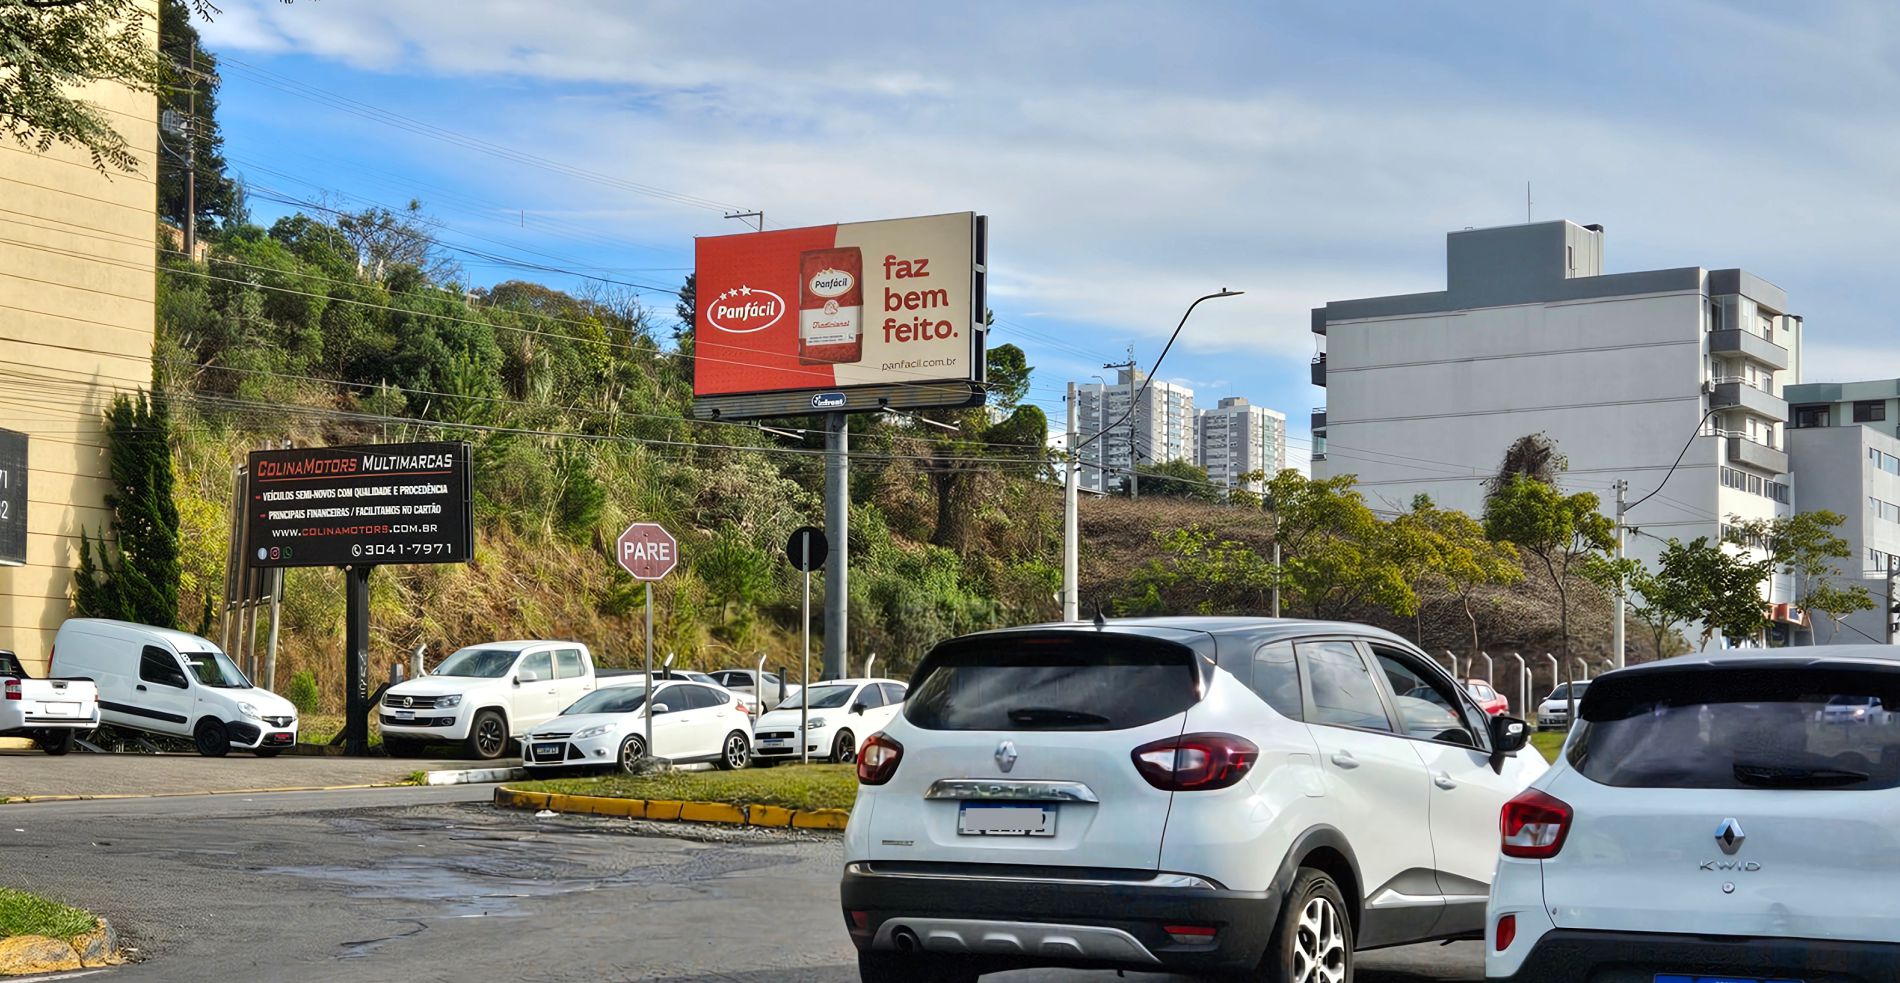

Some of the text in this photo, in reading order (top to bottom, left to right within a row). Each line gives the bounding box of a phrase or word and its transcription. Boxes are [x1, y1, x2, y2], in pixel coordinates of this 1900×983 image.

[883, 255, 930, 280] faz
[815, 278, 848, 289] Panfácil
[884, 287, 949, 312] bem
[717, 301, 775, 321] Panfácil
[882, 316, 959, 344] feito.
[881, 358, 957, 372] panfacil.com.br
[362, 454, 453, 471] MULTIMARCAS
[262, 482, 448, 502] VEÍCULOS SEMI-NOVOS COM QUALIDADE E PROCEDÊNCIA
[268, 509, 305, 521] PRINCIPAIS
[306, 507, 350, 519] FINANCEIRAS
[355, 505, 401, 516] FACILITAMOS
[413, 502, 442, 515] CARTÃO
[365, 543, 452, 556] 3041-7971
[624, 541, 670, 561] PARE
[1699, 860, 1761, 872] KWID
